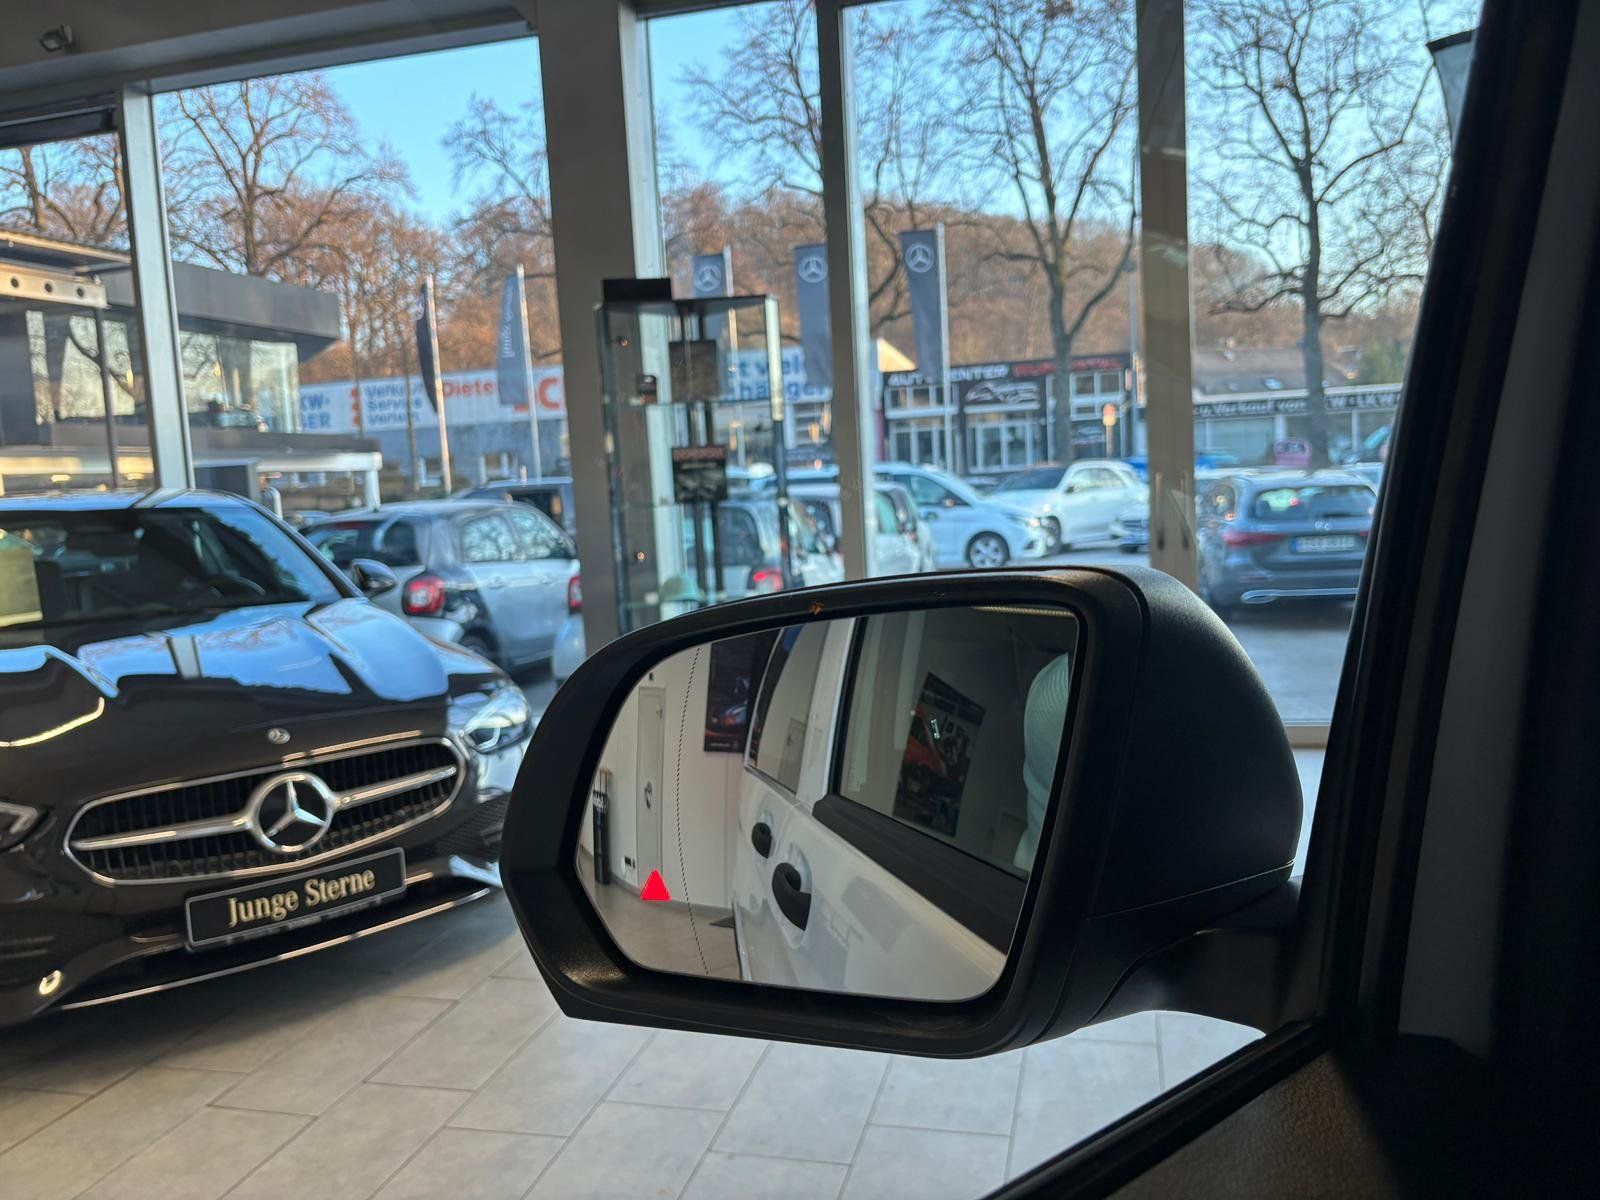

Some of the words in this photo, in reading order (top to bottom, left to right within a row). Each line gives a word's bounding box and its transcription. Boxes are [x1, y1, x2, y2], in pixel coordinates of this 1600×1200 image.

[367, 398, 422, 411] Servie
[228, 889, 300, 928] Junge
[304, 869, 376, 907] Sterne
